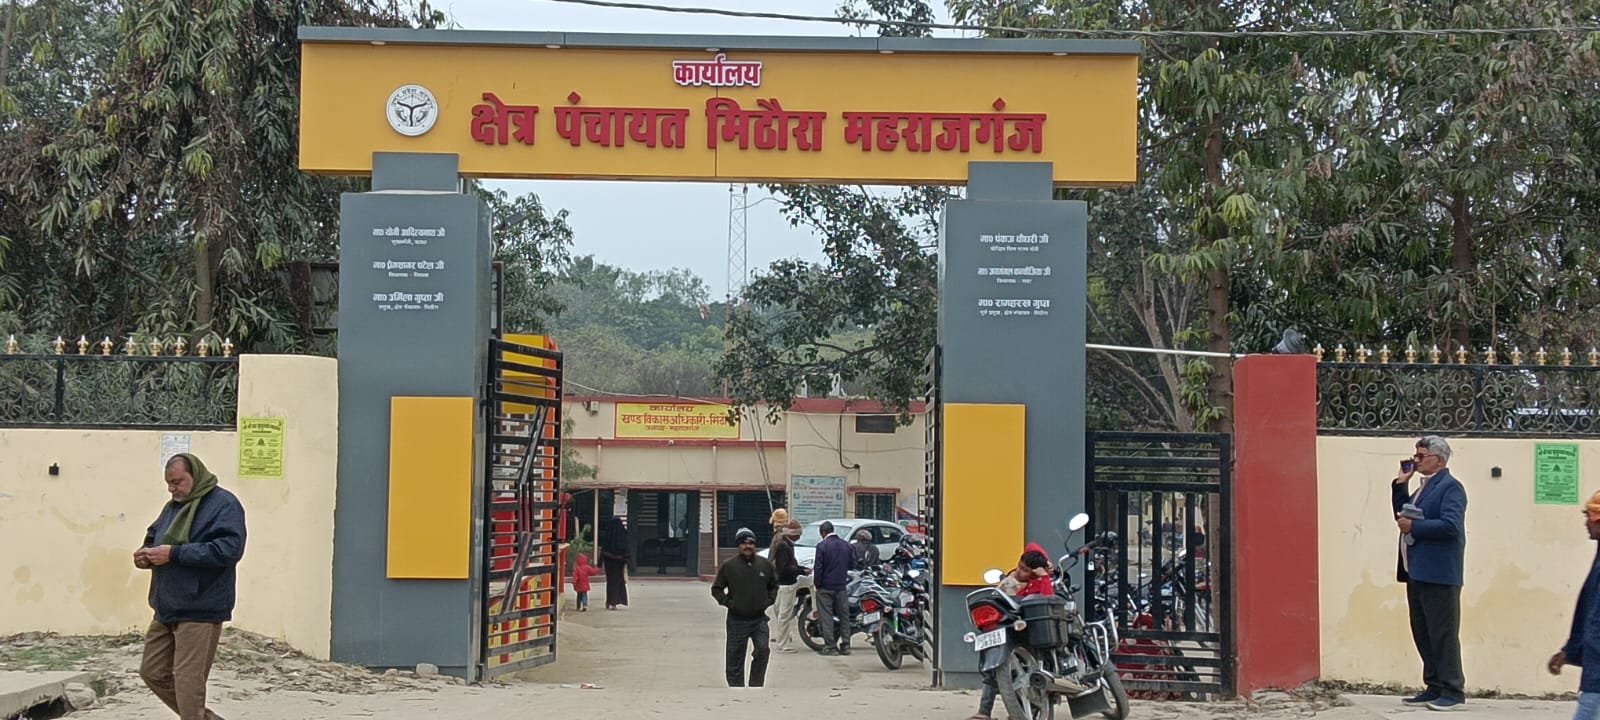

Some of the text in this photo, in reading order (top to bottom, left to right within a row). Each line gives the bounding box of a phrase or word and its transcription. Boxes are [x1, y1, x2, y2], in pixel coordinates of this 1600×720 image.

[672, 53, 762, 86] कार्यालय
[470, 91, 1046, 154] क्षेत्र पंचायत मिठौरा महराजगंज
[621, 414, 641, 424] खण्ड
[644, 413, 670, 425] विकास
[649, 404, 695, 412] कार्यालय
